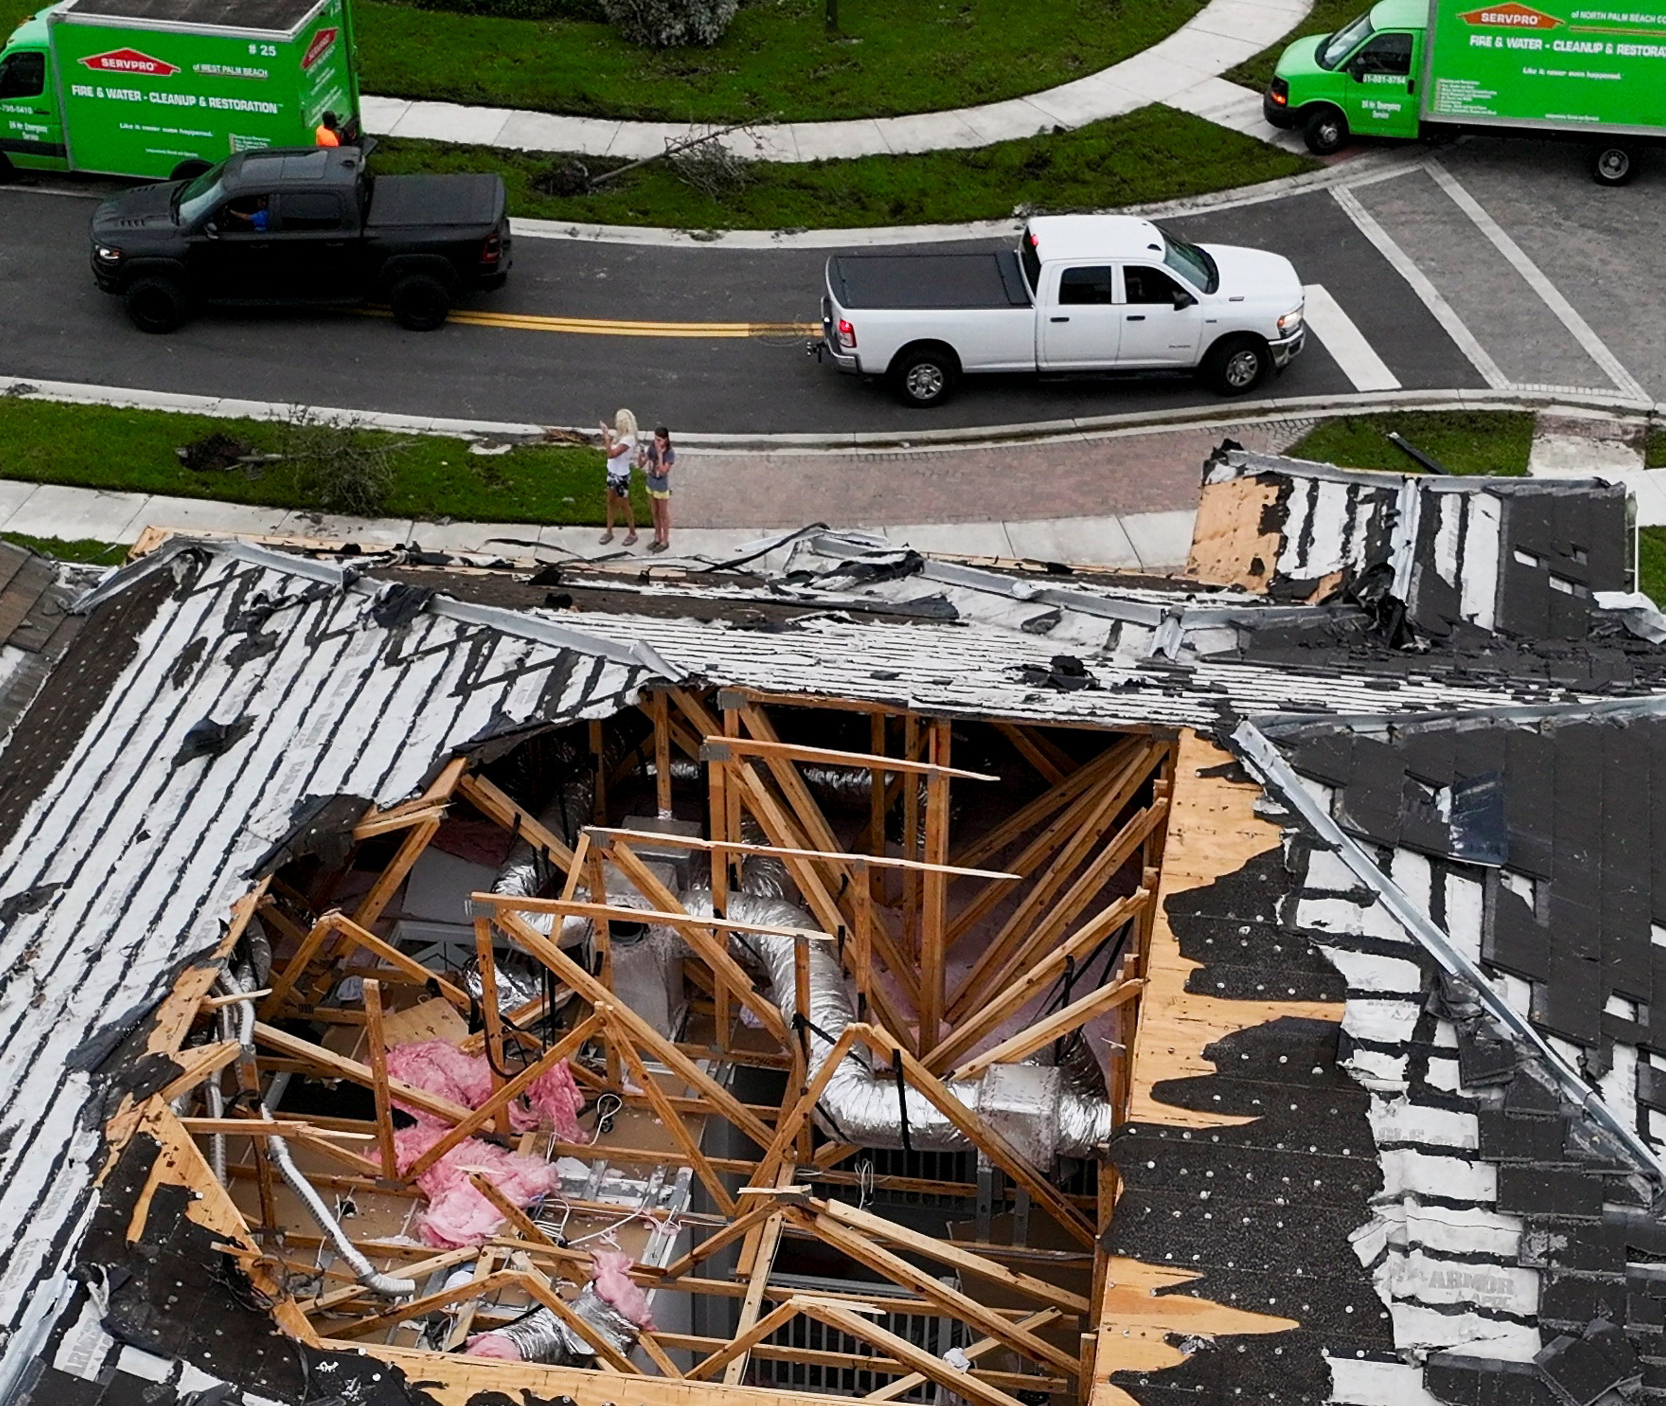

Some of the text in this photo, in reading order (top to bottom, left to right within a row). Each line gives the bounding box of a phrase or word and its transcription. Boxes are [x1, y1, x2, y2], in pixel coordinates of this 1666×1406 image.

[1481, 13, 1539, 25] SERVPRO
[1607, 12, 1628, 22] PALM
[1630, 13, 1656, 23] BEACH
[248, 45, 276, 57] # 25
[1470, 35, 1493, 48] FIRE
[1495, 37, 1503, 48] &
[1507, 36, 1542, 50] WATER
[1553, 40, 1603, 54] CLEANUP
[1605, 43, 1613, 54] &
[101, 58, 155, 71] SERVPRO
[200, 64, 221, 74] WEST
[243, 67, 268, 77] BEACH
[71, 85, 94, 97] FIRE
[96, 86, 104, 98] &
[106, 87, 141, 101] WATER
[149, 92, 196, 106] CLEANUP
[199, 96, 207, 107] &
[209, 97, 278, 114] RESTORATION
[1428, 1270, 1514, 1295] ARMOR
